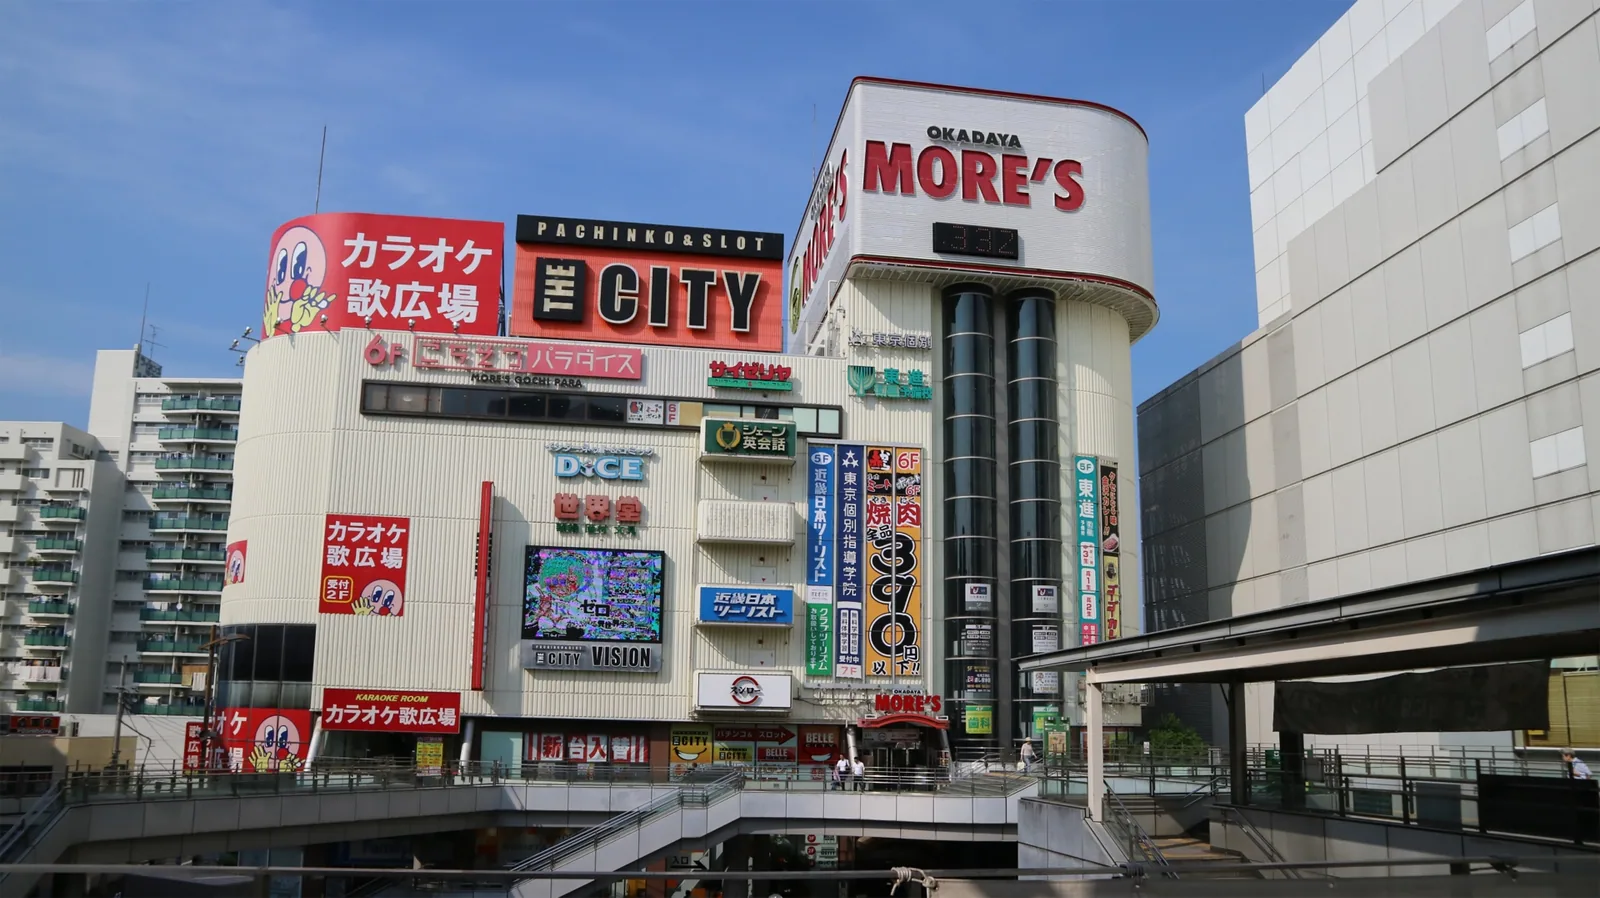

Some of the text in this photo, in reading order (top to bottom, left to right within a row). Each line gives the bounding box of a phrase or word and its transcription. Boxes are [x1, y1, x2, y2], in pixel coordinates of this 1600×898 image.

[926, 125, 1021, 149] OKADAYA
[863, 139, 1086, 213] MORE'S
[801, 148, 848, 308] MORE'S
[341, 231, 493, 277] カラオケ
[346, 278, 479, 325] 歌広場
[544, 262, 764, 333] THE CITY
[872, 332, 933, 350] 東京個別
[364, 333, 403, 372] 6F
[709, 360, 792, 383] サイゼリヤ
[883, 368, 924, 387] 東進
[470, 372, 583, 390] MORE'S GOCHI PARA
[742, 424, 787, 438] シェーン
[742, 437, 787, 452] 英会話
[813, 453, 830, 464] 5F
[897, 452, 920, 470] 6F
[1080, 463, 1093, 471] 5F
[905, 485, 921, 497] 6F
[1078, 479, 1095, 519] 東進
[554, 492, 643, 523] 世界堂
[327, 521, 407, 544] カラオケ
[813, 468, 828, 583] 近畿日本ツーリスト
[842, 471, 858, 598] 東京個別指導学院
[867, 524, 893, 541] 全品
[326, 545, 404, 569] 歌広場
[327, 579, 350, 590] 受付
[326, 590, 350, 600] 2F
[713, 592, 778, 605] 近畿日本
[870, 533, 918, 657] 390
[713, 605, 784, 618] ツーリスト
[818, 608, 829, 671] クラブツーリズム
[548, 652, 581, 666] CITY
[591, 645, 651, 668] VISION
[838, 655, 860, 664] 受付中
[903, 645, 920, 662] 円
[840, 666, 858, 676] 7F
[355, 693, 428, 703] KARAOKE ROOM
[730, 686, 761, 695] スシロー
[875, 694, 942, 712] MORE'S
[325, 703, 457, 727] カラオケ歌広場
[681, 735, 708, 747] CITY
[759, 730, 787, 739] スロット
[805, 732, 834, 744] BELLE
[542, 735, 631, 760] 新台入替
[726, 751, 748, 761] CITY
[765, 748, 789, 757] BELLE
[672, 855, 689, 865] 入口
